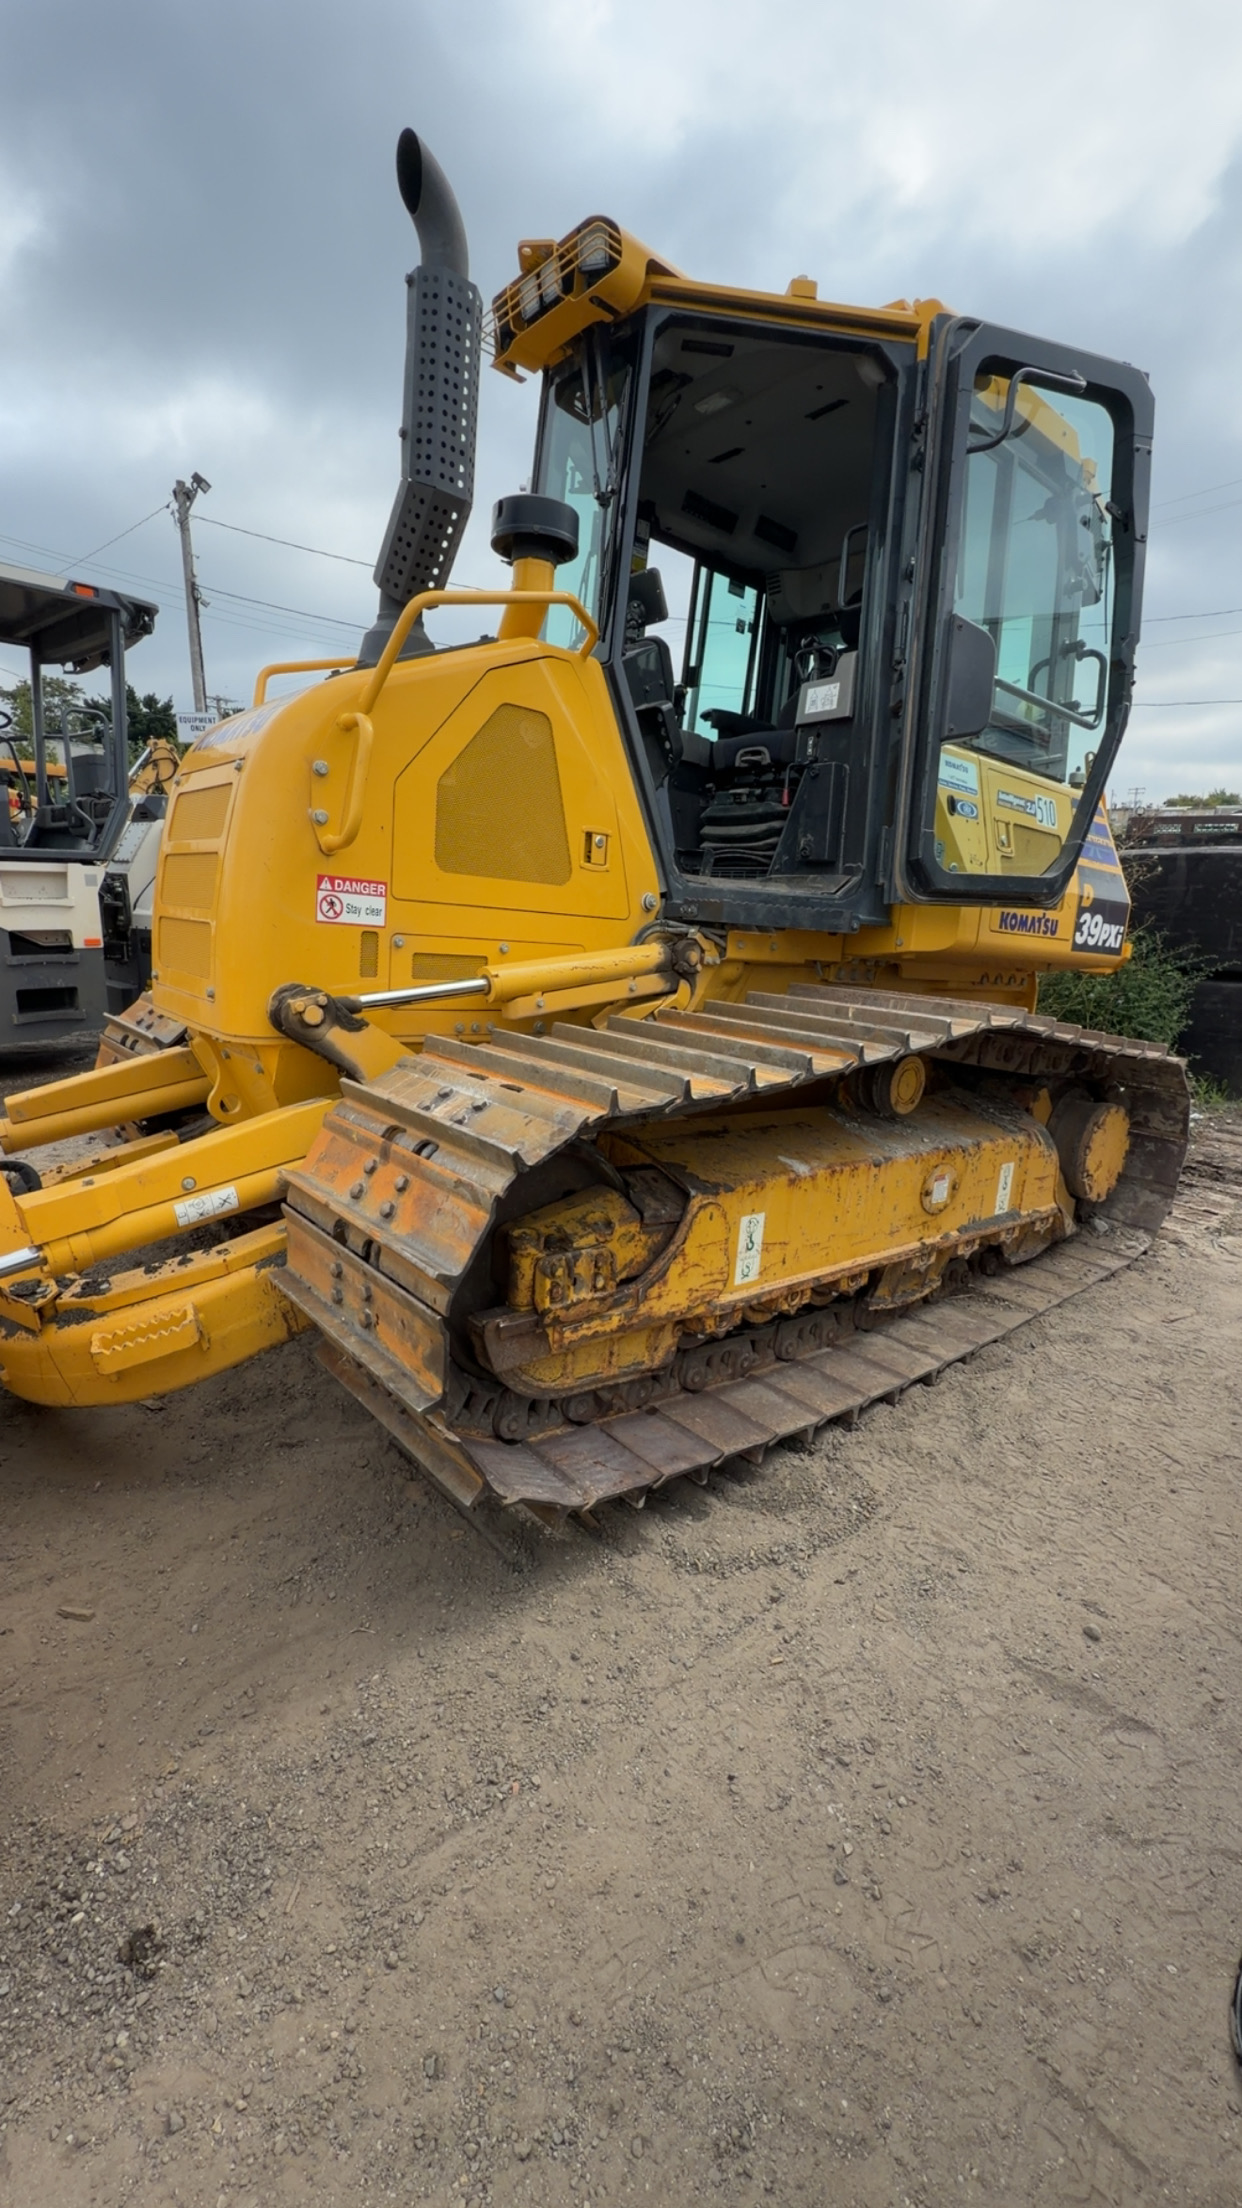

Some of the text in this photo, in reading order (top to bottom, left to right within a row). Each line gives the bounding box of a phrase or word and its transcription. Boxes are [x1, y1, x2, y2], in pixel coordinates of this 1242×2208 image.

[178, 716, 217, 725] EQUIPMENT
[1037, 797, 1056, 827] 510
[334, 879, 386, 896] DANGER
[1081, 883, 1095, 908] D
[346, 903, 382, 917] Stay clear
[998, 911, 1059, 937] KOMATSU
[1075, 912, 1125, 949] 39PXi
